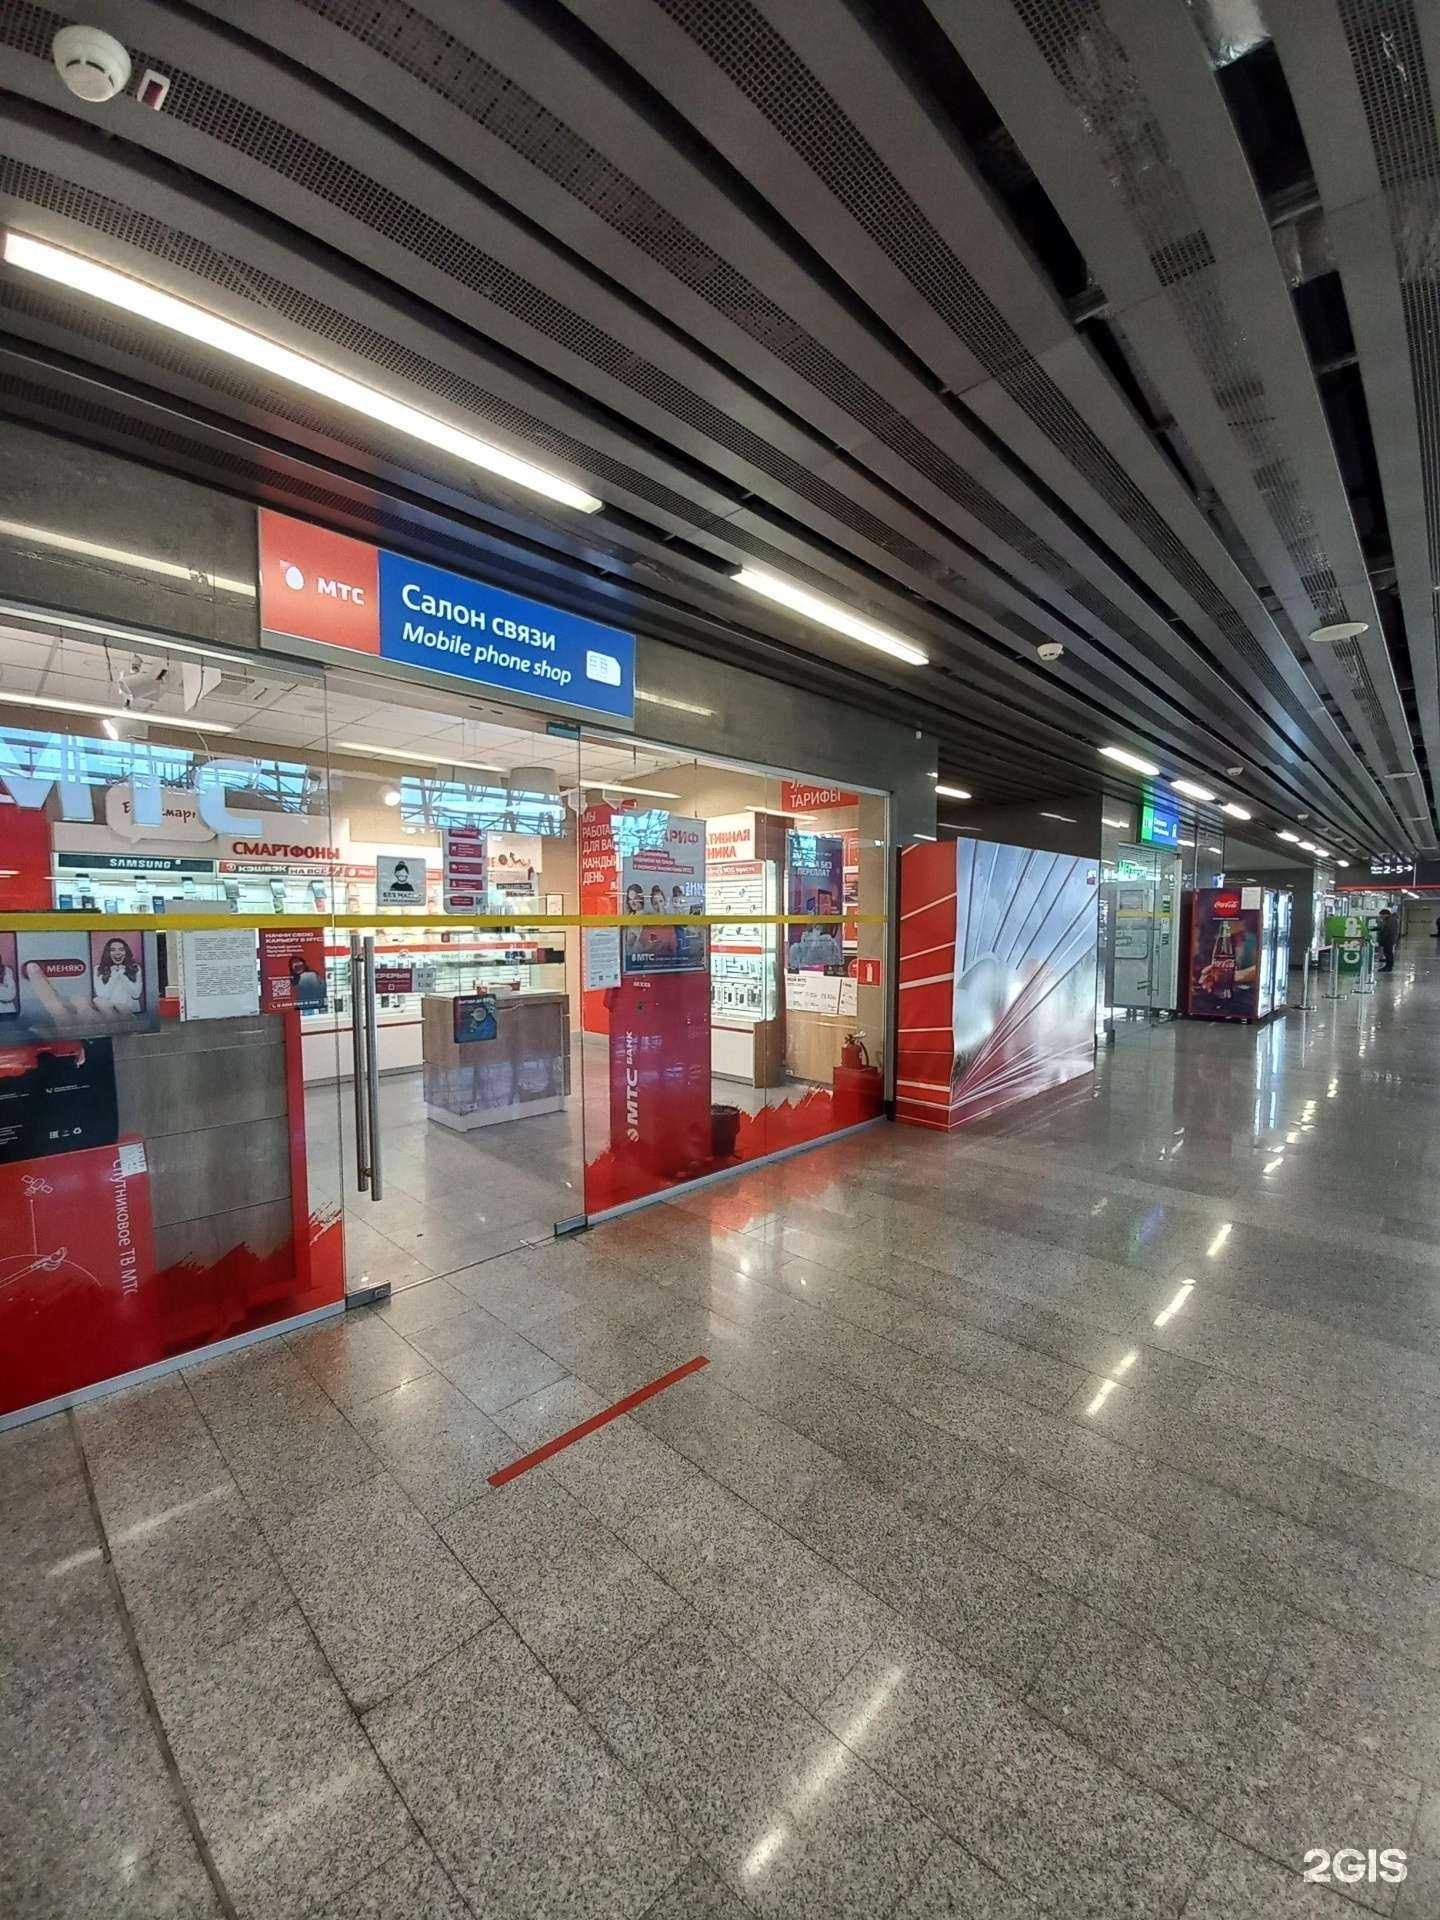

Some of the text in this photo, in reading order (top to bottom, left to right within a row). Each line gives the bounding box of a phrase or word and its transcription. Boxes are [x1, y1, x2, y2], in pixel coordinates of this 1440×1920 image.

[317, 576, 365, 606] МТС
[402, 584, 556, 652] Салон связи
[402, 622, 572, 686] Mobile phone shop
[790, 790, 841, 808] ТАРИФЫ
[582, 824, 610, 838] РАБОТА
[664, 829, 699, 844] РИФ
[706, 829, 750, 845] ТИВНАЯ
[232, 841, 340, 860] СМАРТФОНЫ
[706, 845, 737, 860] НИКА
[109, 857, 171, 870] SAMSUNG
[582, 871, 605, 886] ДЕНЬ
[47, 964, 84, 973] МЕНЯЮ
[626, 1068, 639, 1126] МТС
